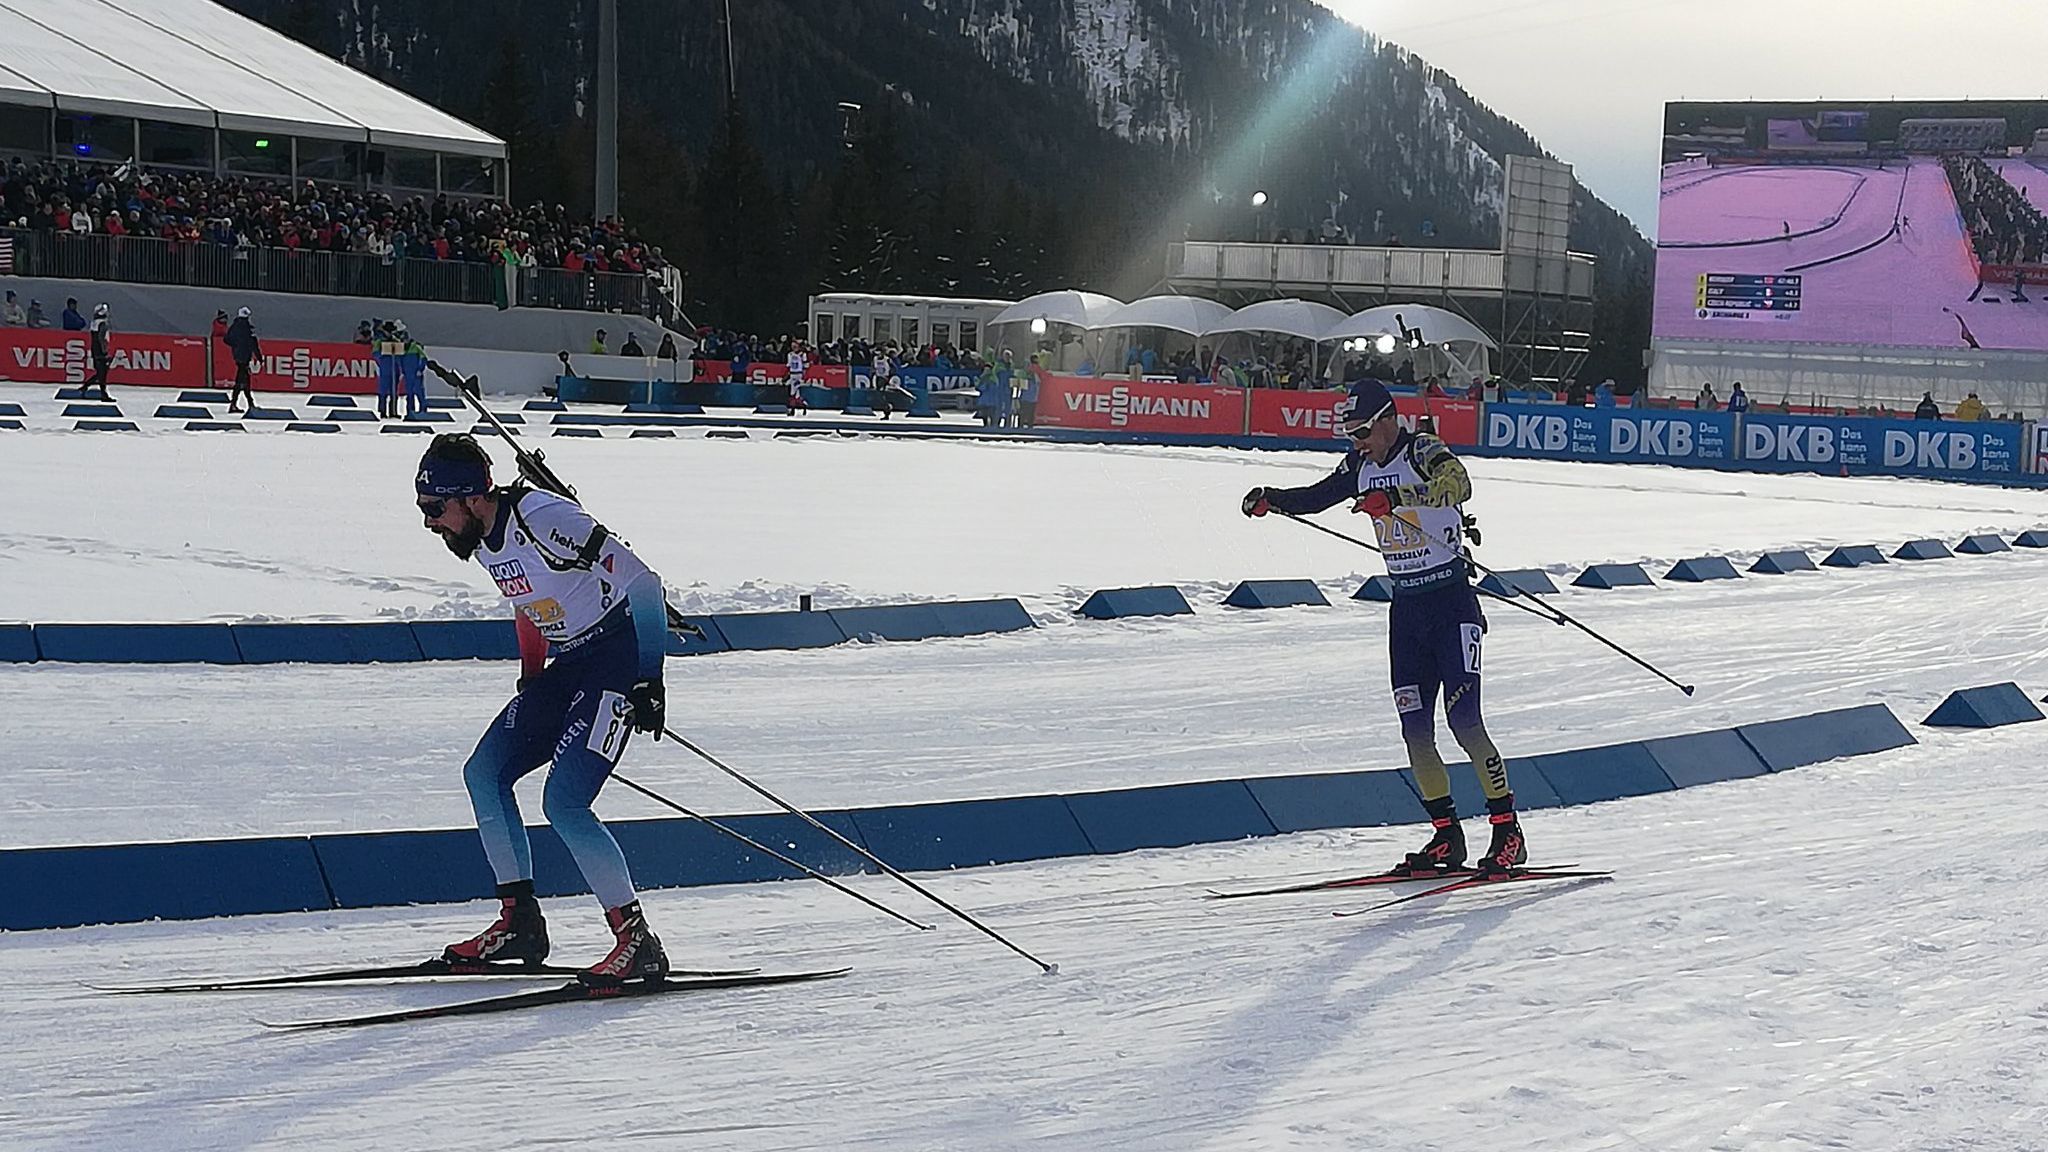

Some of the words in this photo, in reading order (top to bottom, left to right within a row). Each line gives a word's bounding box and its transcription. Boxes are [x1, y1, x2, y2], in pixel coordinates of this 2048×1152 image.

[13, 340, 172, 383] VIESSANN
[1063, 386, 1210, 427] VIESSMANN
[1573, 417, 1592, 430] Das
[1699, 422, 1719, 435] Das
[1488, 412, 1568, 451] DKB
[1572, 430, 1597, 441] kann
[1610, 417, 1693, 457] DKB
[1840, 427, 1862, 440] Das
[1698, 434, 1723, 446] kann
[1745, 423, 1835, 463] DKB
[1840, 440, 1867, 453] kann
[1982, 434, 2004, 447] Das
[1572, 441, 1597, 454] Bank
[1698, 446, 1723, 459] Bank
[1883, 429, 1977, 470] DKB
[1982, 447, 2010, 459] kann
[1839, 452, 1867, 465] Bank
[1981, 459, 2010, 472] Bank
[1375, 518, 1409, 547] 24
[490, 560, 525, 580] LIQUI
[500, 578, 531, 597] MOLY
[1485, 754, 1507, 792] UKR
